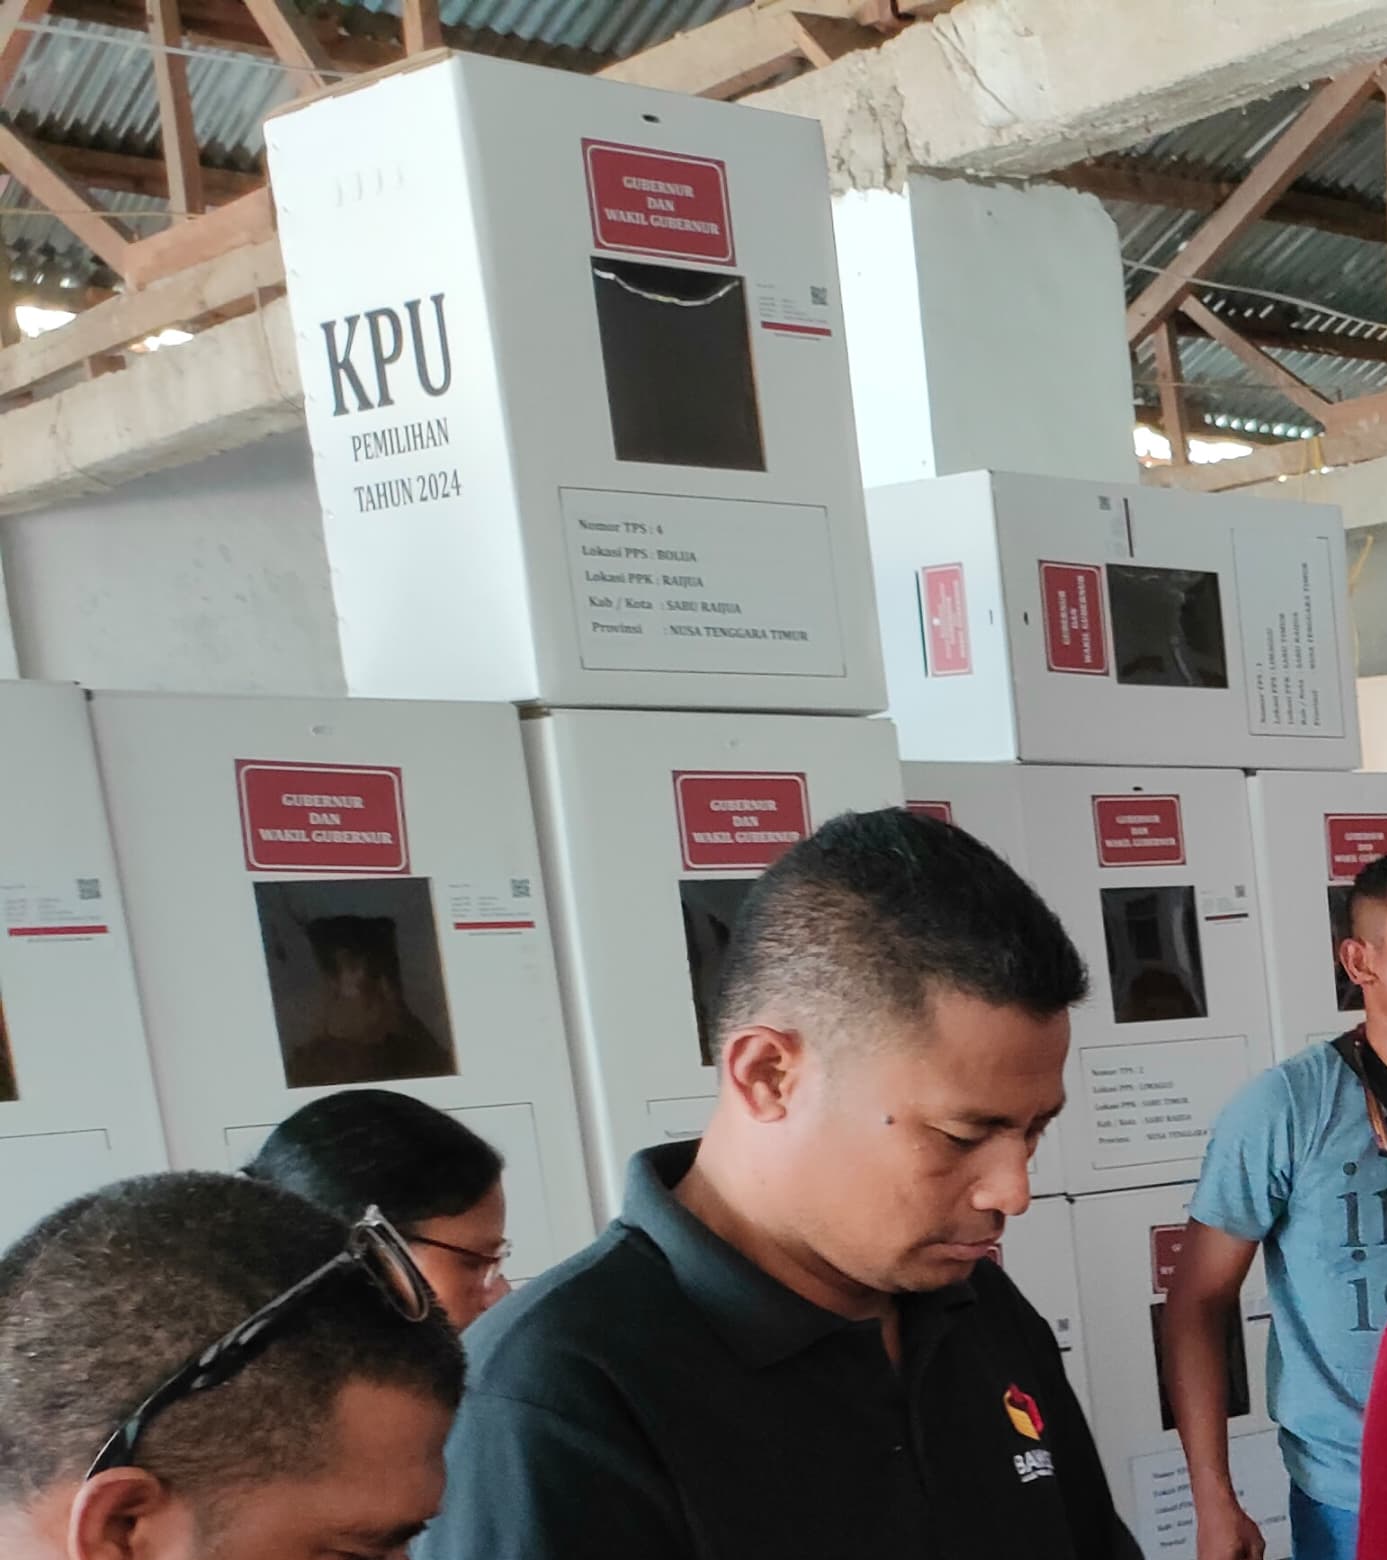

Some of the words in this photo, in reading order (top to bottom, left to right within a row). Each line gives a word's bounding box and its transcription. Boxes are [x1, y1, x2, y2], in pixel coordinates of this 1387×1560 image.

[646, 196, 675, 212] DAN
[320, 292, 452, 417] KPU
[351, 417, 450, 463] PEMILIHAN
[353, 477, 413, 513] TAHUN
[417, 469, 462, 502] 2024
